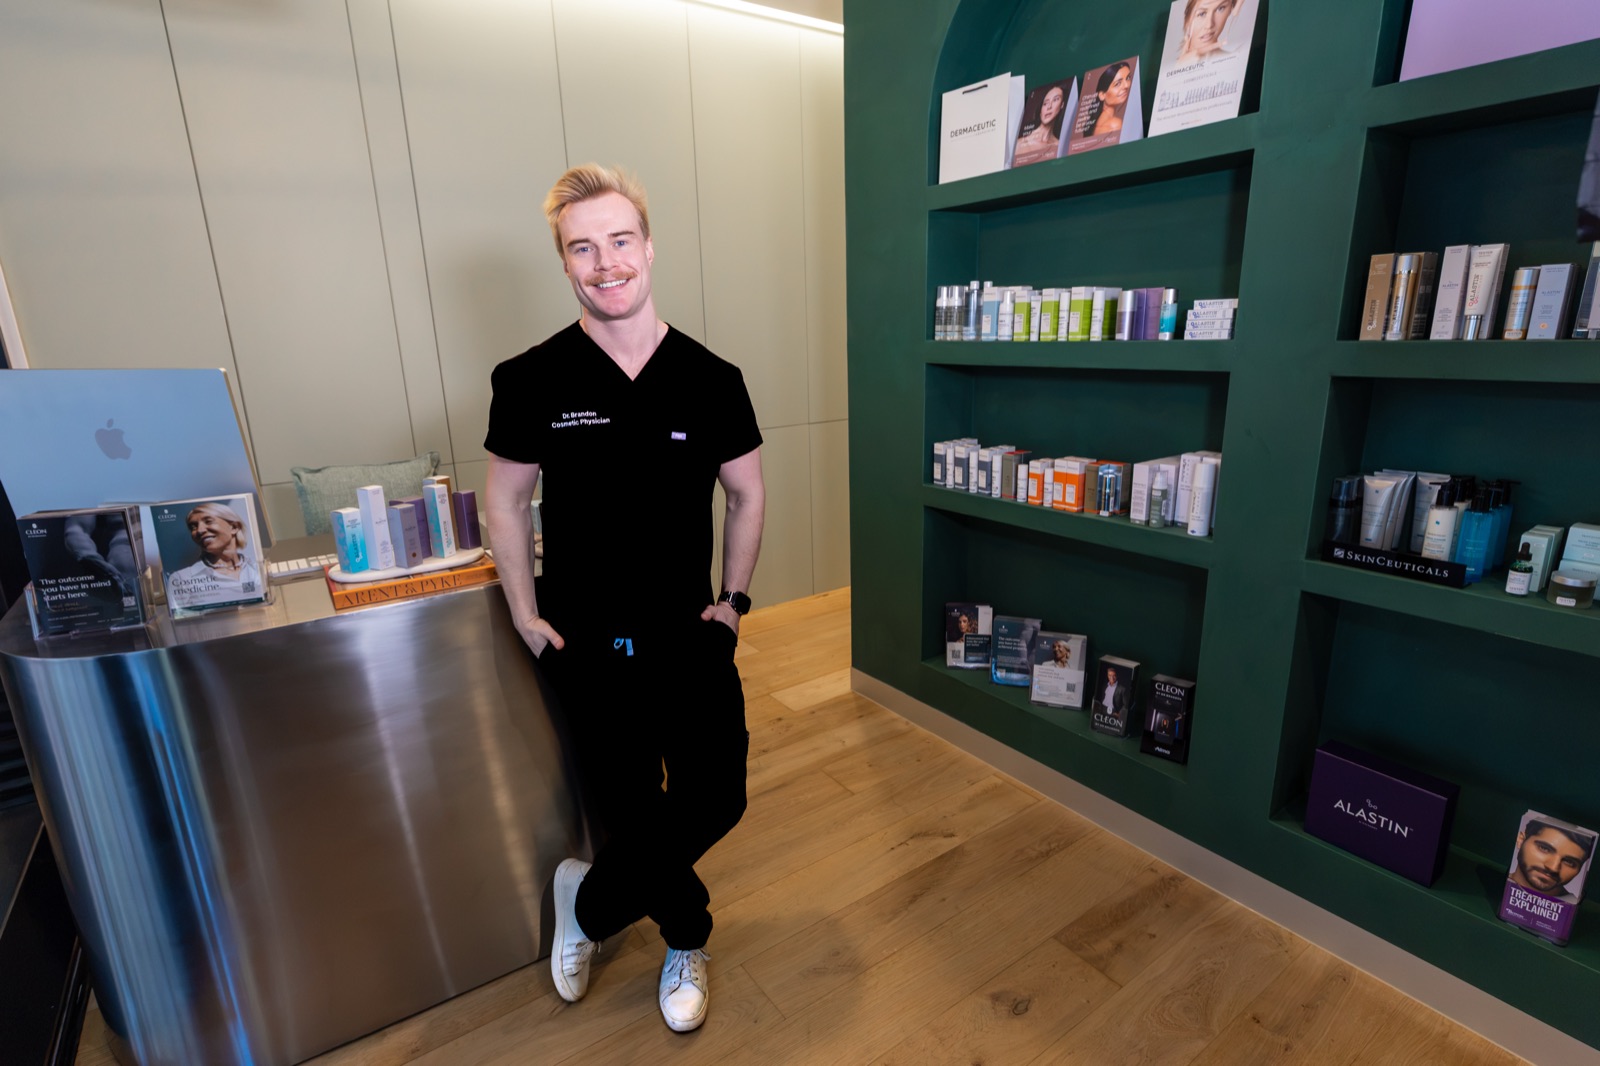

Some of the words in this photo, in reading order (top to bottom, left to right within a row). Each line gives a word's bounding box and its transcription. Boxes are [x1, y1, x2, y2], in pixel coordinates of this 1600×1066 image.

[1166, 61, 1205, 78] DERMACEUTIC
[950, 119, 996, 138] DERMACEUTIC
[1470, 274, 1479, 301] ALASTIN
[570, 410, 597, 418] Brandon
[551, 419, 579, 428] Cosmetic
[580, 417, 611, 426] Physician
[58, 575, 95, 583] outcome
[172, 574, 217, 587] Cosmetic
[41, 586, 58, 595] you
[59, 583, 79, 592] have
[80, 581, 89, 589] in
[90, 580, 111, 588] mind
[342, 584, 401, 606] ARENT
[405, 583, 417, 595] &
[420, 574, 462, 592] PYKE
[43, 592, 66, 601] starts
[67, 590, 88, 599] here.
[1155, 682, 1185, 697] CLEON
[1094, 713, 1123, 728] CLEON
[1154, 746, 1171, 755] Alma
[1333, 799, 1409, 838] ALASTIN
[1510, 887, 1564, 914] TREATMENT
[1509, 896, 1559, 922] EXPLAINED
